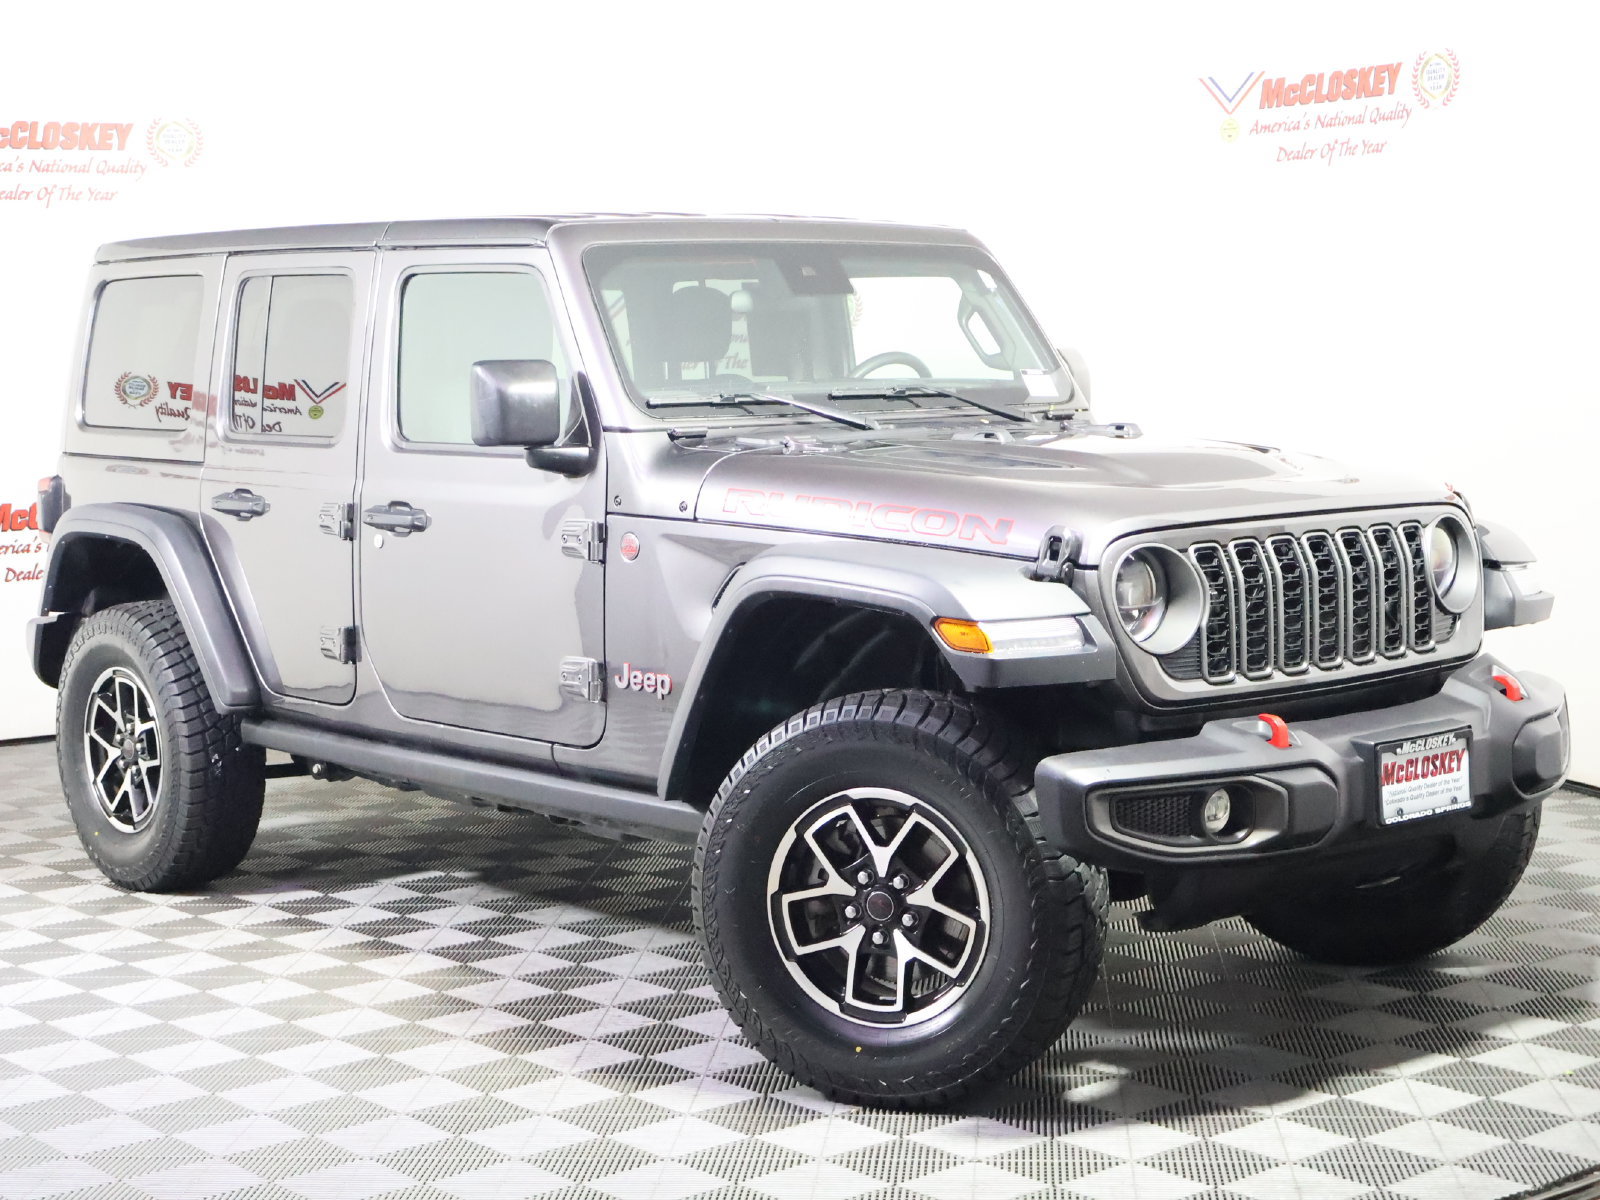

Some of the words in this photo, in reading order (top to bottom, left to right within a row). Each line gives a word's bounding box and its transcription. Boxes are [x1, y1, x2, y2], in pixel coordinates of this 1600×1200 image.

[1259, 62, 1403, 109] McCLOSKEY
[1249, 112, 1310, 135] America's
[1314, 105, 1367, 129] National
[1369, 101, 1412, 128] Quality
[0, 120, 134, 151] cCLOSKEY
[1276, 142, 1318, 162] Dealer
[1320, 138, 1339, 166] Of
[1337, 138, 1358, 157] The
[1361, 139, 1387, 155] Year
[28, 156, 95, 174] National
[96, 157, 147, 182] Quality
[0, 184, 34, 201] ealer
[37, 184, 58, 209] Of
[59, 185, 83, 201] The
[88, 187, 119, 202] Year
[5, 562, 44, 582] Deale
[614, 663, 672, 699] Jeep
[1401, 732, 1455, 754] McCLOSKEY
[1381, 748, 1466, 786] McCLOSKEY
[1385, 809, 1433, 825] COLORADO
[1434, 801, 1472, 814] SPRINGS
